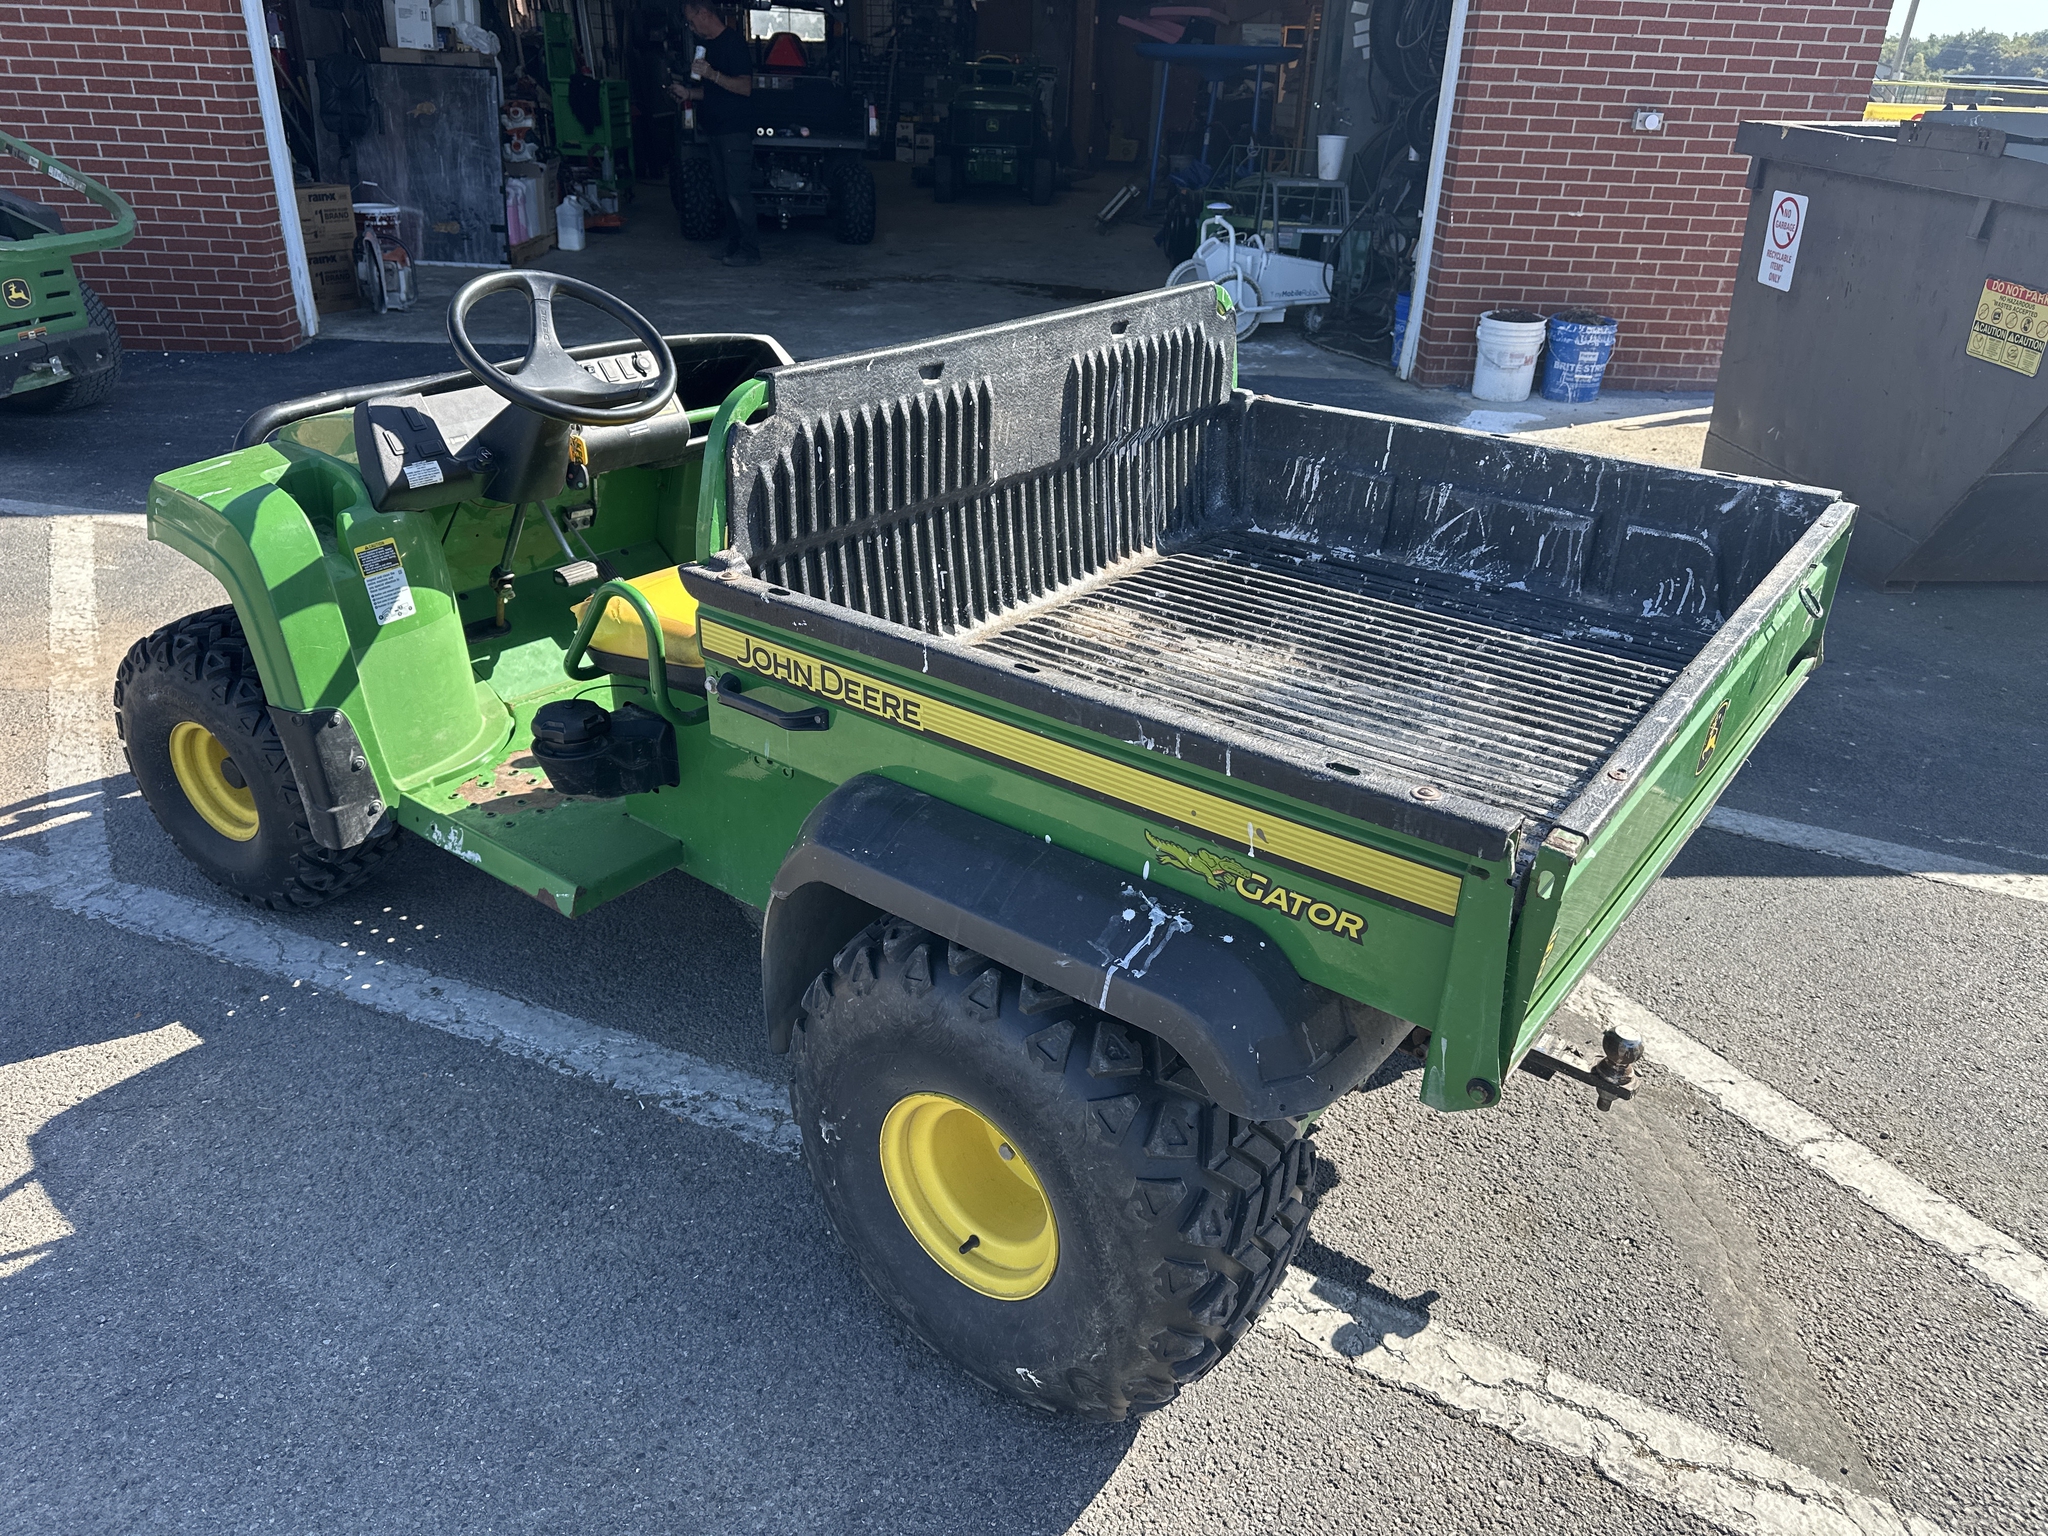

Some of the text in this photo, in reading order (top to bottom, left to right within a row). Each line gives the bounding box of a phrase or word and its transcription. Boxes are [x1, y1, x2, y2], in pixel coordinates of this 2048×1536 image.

[324, 212, 349, 220] BRAND
[1784, 209, 1791, 218] NO
[1775, 220, 1795, 232] GARBAGE
[1767, 250, 1792, 263] RECYCLABLE
[1770, 262, 1783, 272] ITEMS
[1769, 273, 1780, 283] ONLY
[1992, 281, 2004, 291] DO
[2006, 285, 2025, 297] NOT
[1993, 302, 2038, 318] WASTES ACCEPTED
[2006, 298, 2035, 310] HAZARDOUS
[1980, 323, 2007, 339] CAUTION
[2014, 335, 2044, 350] CAUTION
[1554, 361, 1582, 373] BRITE
[737, 638, 921, 727] JOHN DEERE
[1235, 872, 1365, 940] GATOR
